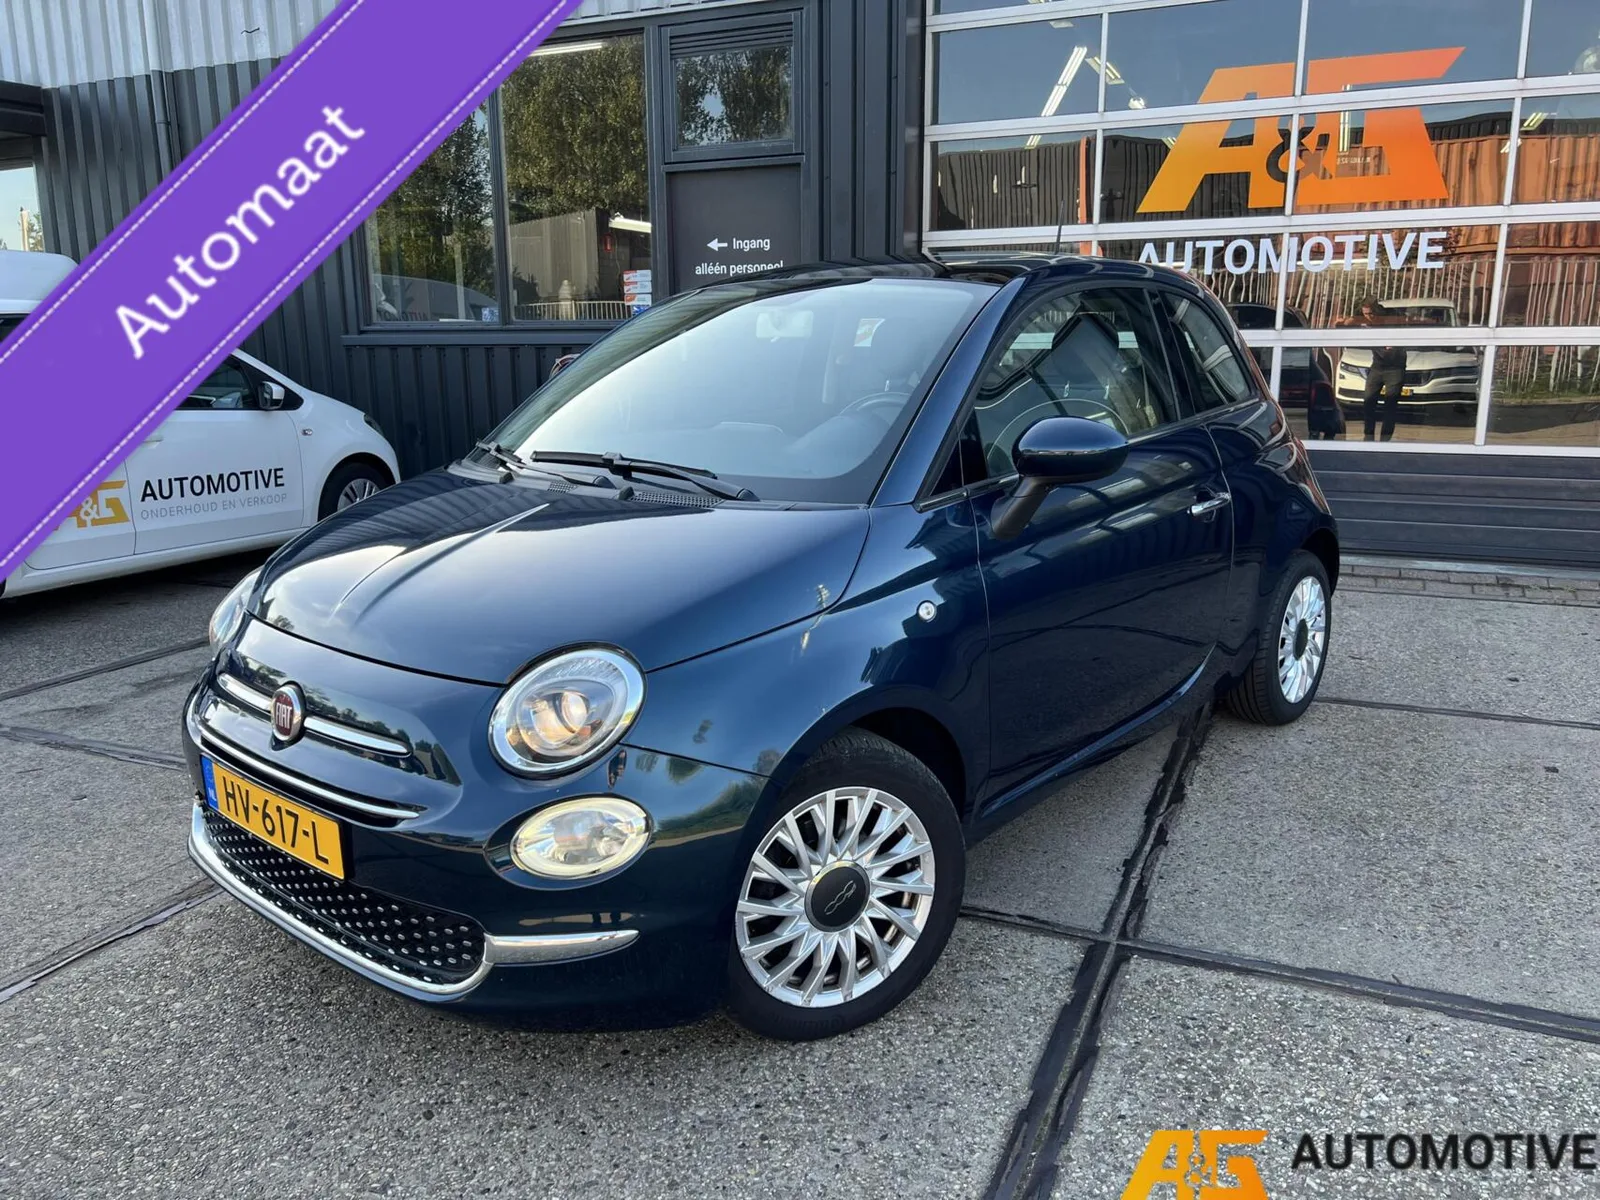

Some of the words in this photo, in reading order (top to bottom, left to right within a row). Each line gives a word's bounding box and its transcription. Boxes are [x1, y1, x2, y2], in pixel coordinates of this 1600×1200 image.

[1136, 46, 1466, 213] A&G
[732, 237, 771, 252] Ingang
[1137, 231, 1447, 276] AUTOMOTIVE
[695, 262, 727, 275] alléén
[141, 467, 285, 502] AUTOMOTIVE
[140, 501, 218, 520] ONDERHOUD
[222, 499, 237, 510] EN
[240, 493, 287, 508] VERKOOP
[275, 701, 294, 730] FIAT
[222, 775, 330, 865] HV-617-L
